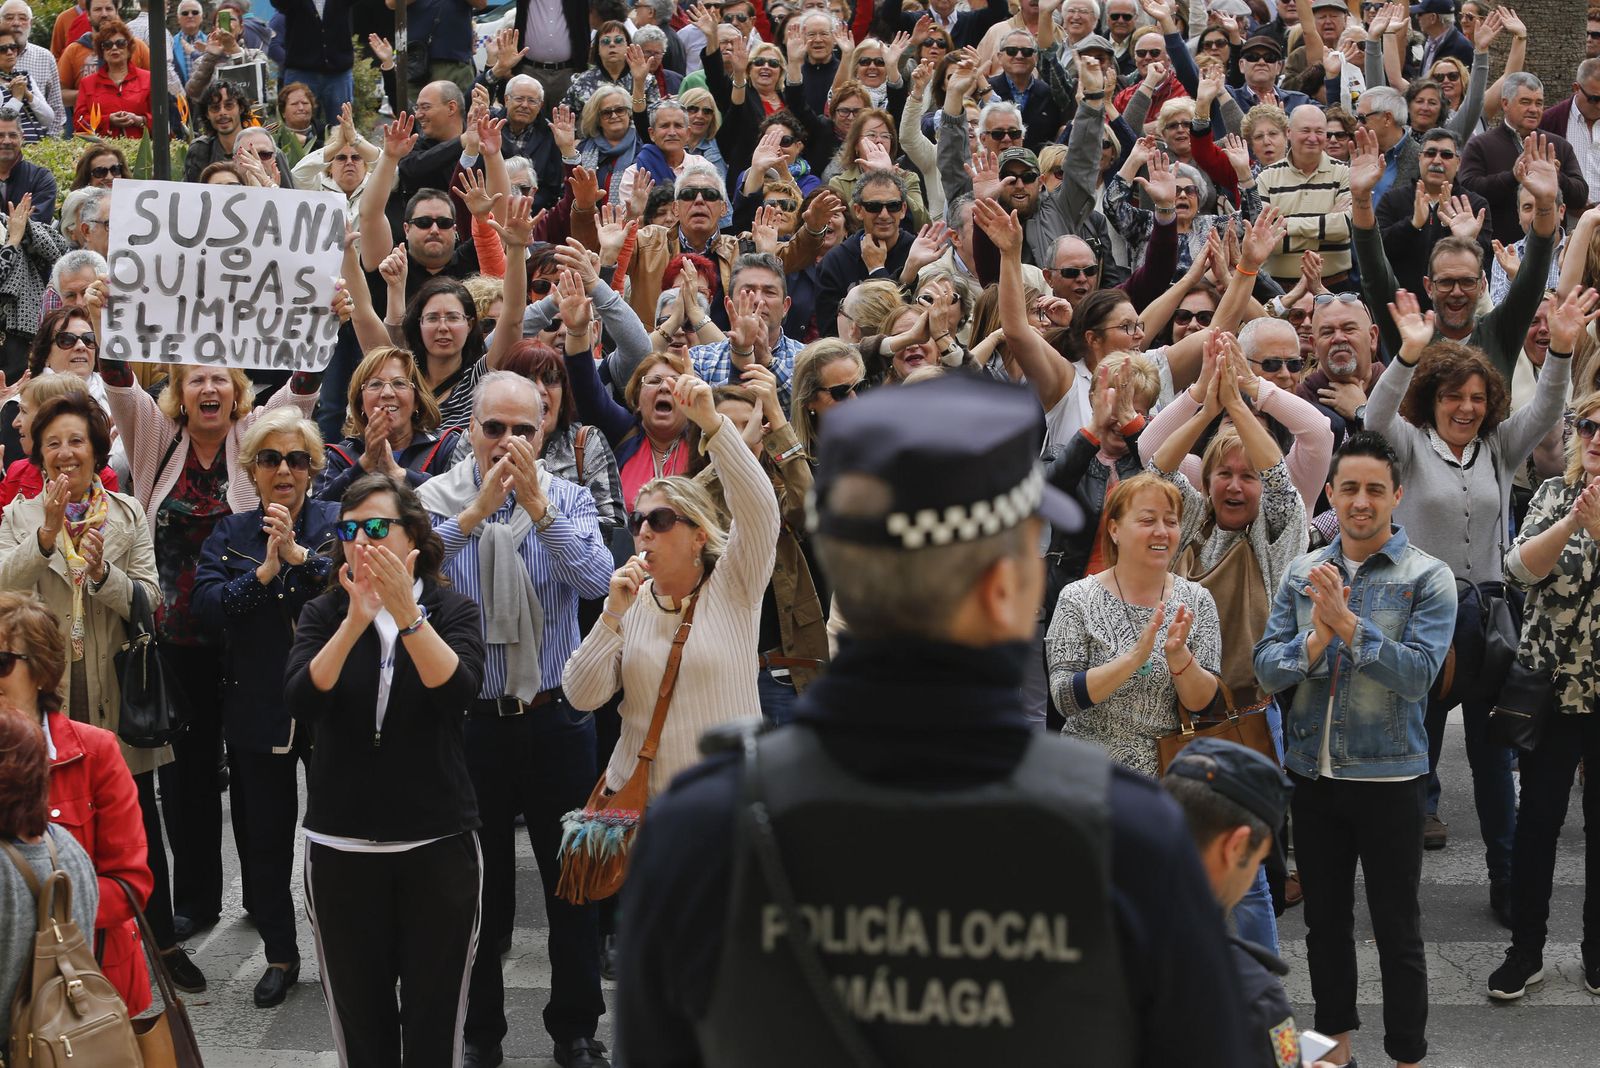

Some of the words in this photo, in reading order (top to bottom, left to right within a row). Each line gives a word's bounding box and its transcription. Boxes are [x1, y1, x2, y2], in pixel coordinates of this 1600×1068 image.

[128, 189, 345, 255] SUSANA
[107, 294, 163, 335] EL
[105, 334, 132, 360] O
[137, 333, 186, 363] TE
[937, 909, 1081, 962] LOCAL
